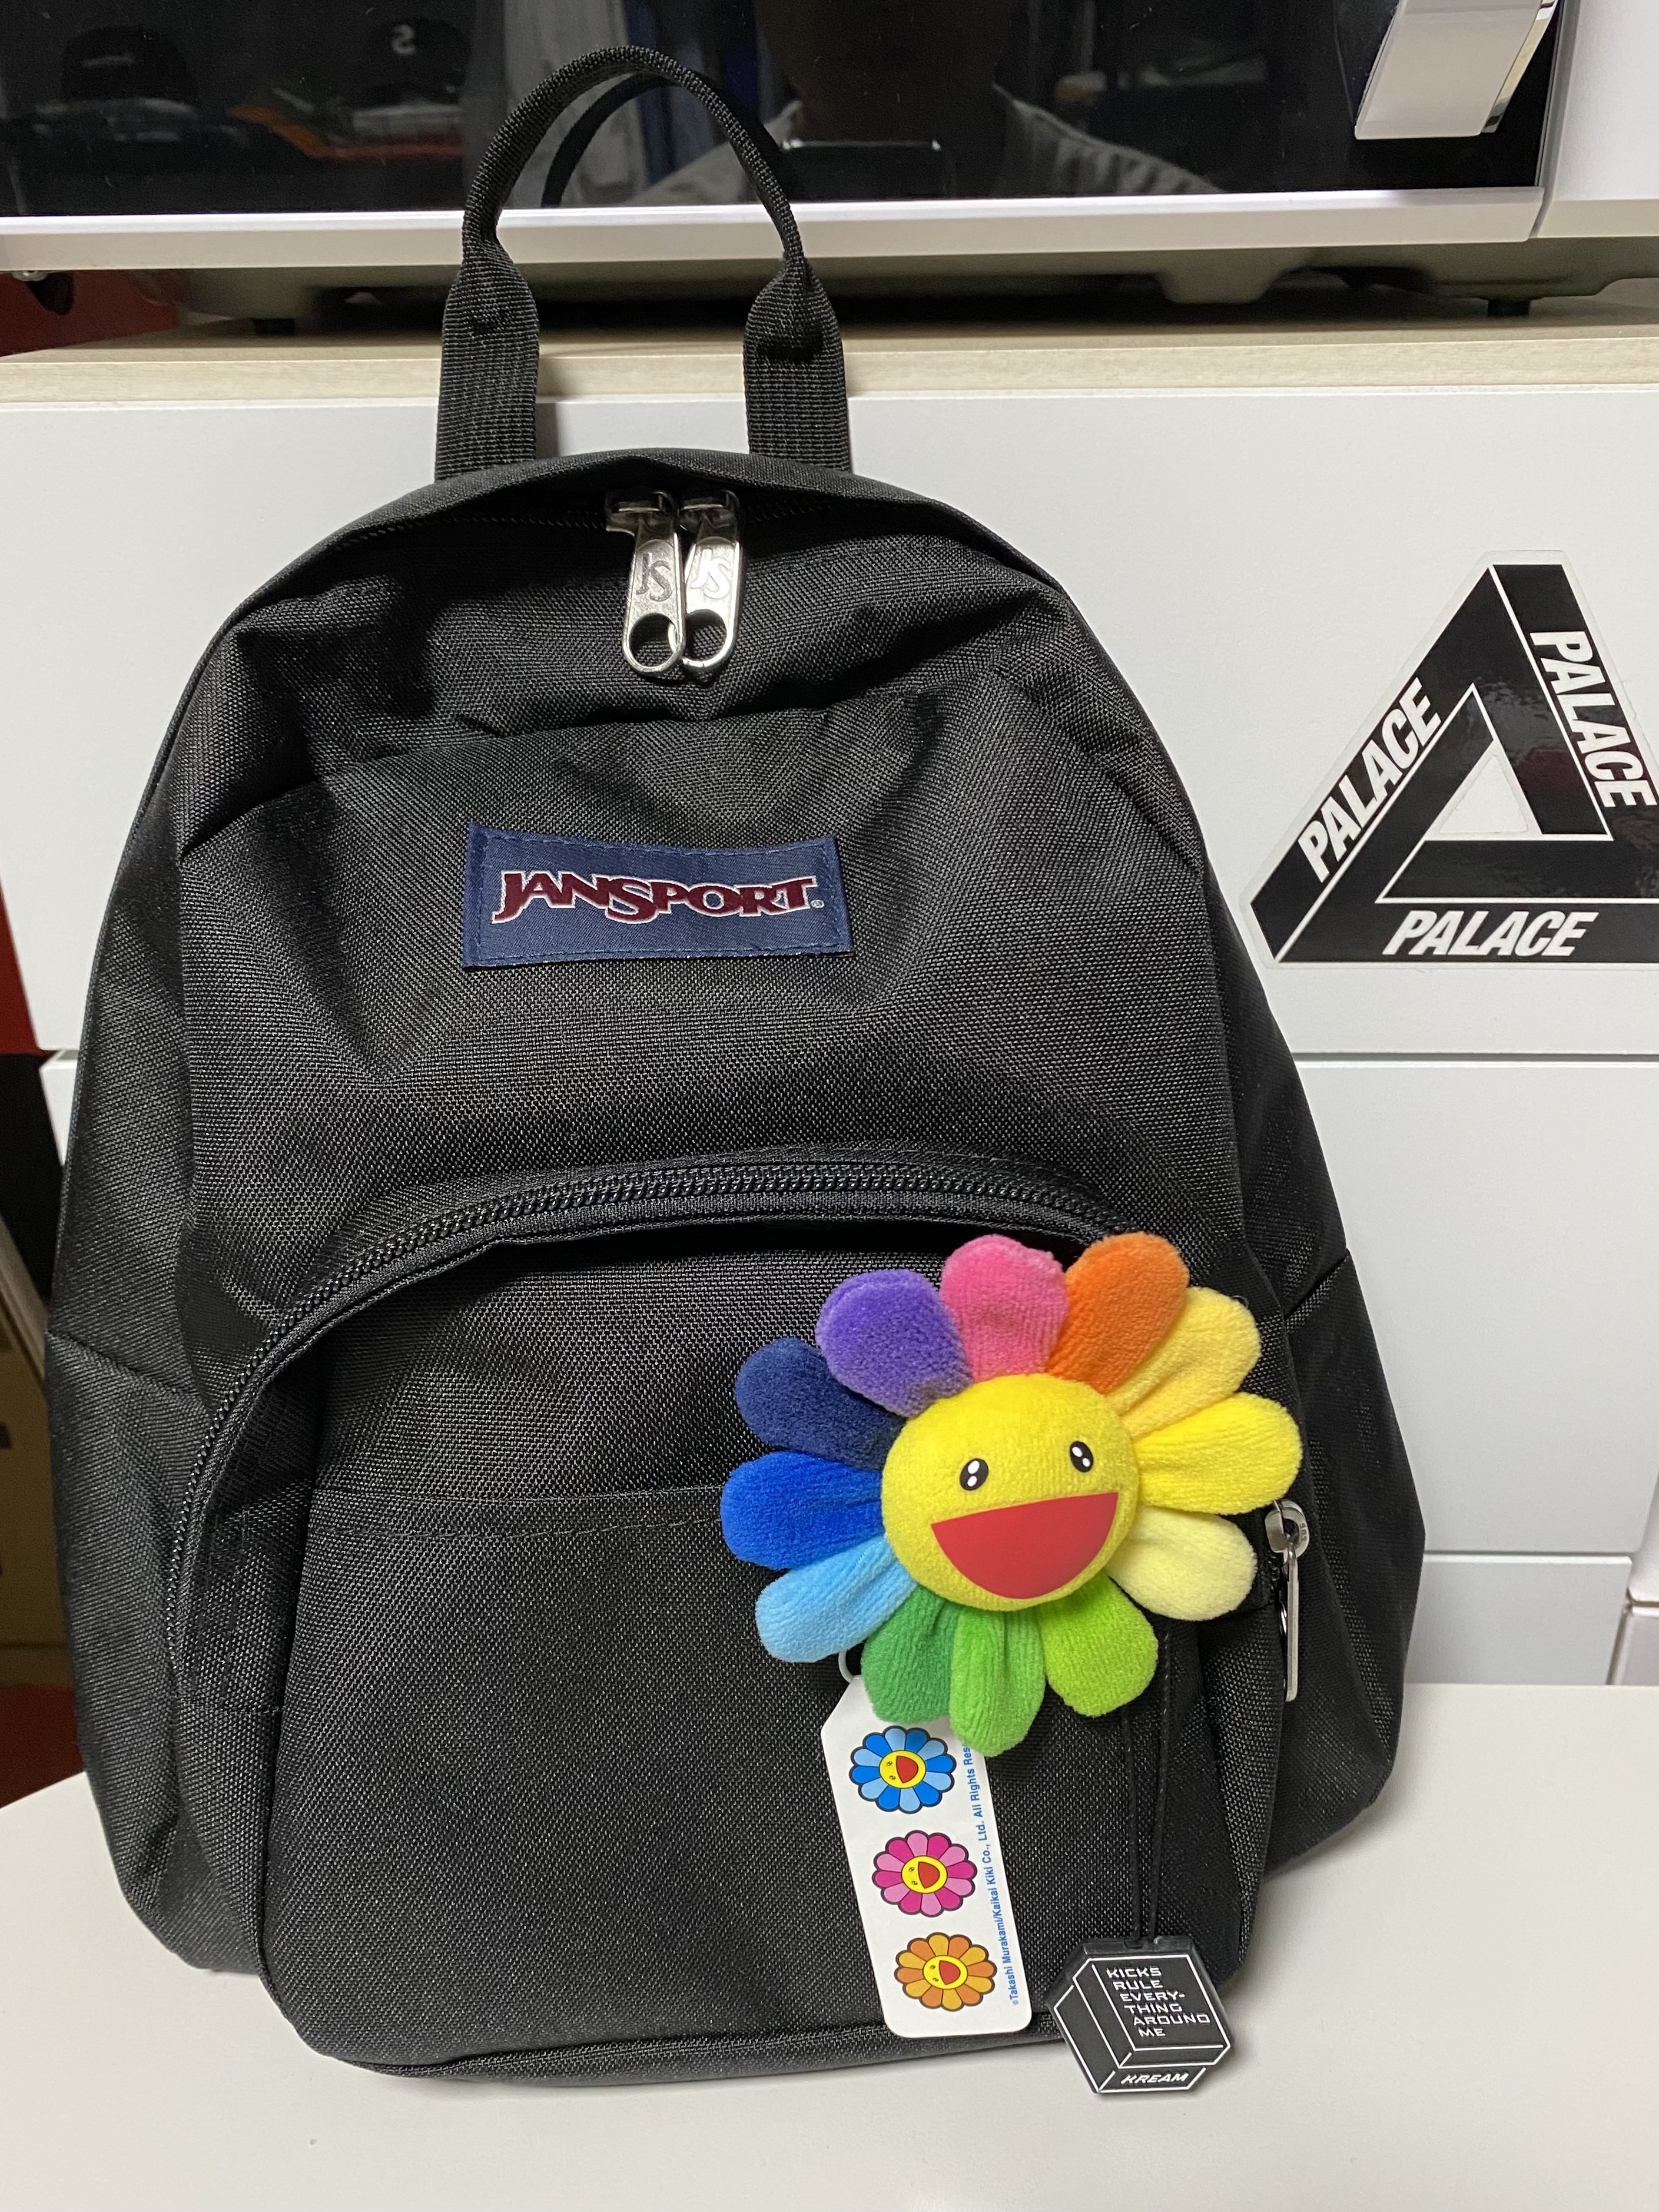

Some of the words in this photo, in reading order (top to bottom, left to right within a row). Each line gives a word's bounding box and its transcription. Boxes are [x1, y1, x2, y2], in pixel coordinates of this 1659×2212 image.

[1529, 631, 1658, 808] PALACE
[1298, 676, 1442, 883] PALACE
[1381, 910, 1600, 957] PALACE
[962, 1743, 974, 1765] Res
[967, 1768, 981, 1802] Rights
[972, 1803, 983, 1818] All
[976, 1821, 988, 1841] Ltd.
[984, 1866, 996, 1885] Kiki
[988, 1888, 1012, 1964] Murakami/Kaikai
[1106, 1966, 1162, 1979] KICKS
[1113, 1979, 1163, 1991] RULE
[1120, 1991, 1186, 2002] EVERY-
[1124, 2003, 1183, 2014] THING
[1133, 2014, 1211, 2026] AROUND
[1137, 2027, 1166, 2038] ME
[1120, 2073, 1189, 2085] KREAM
